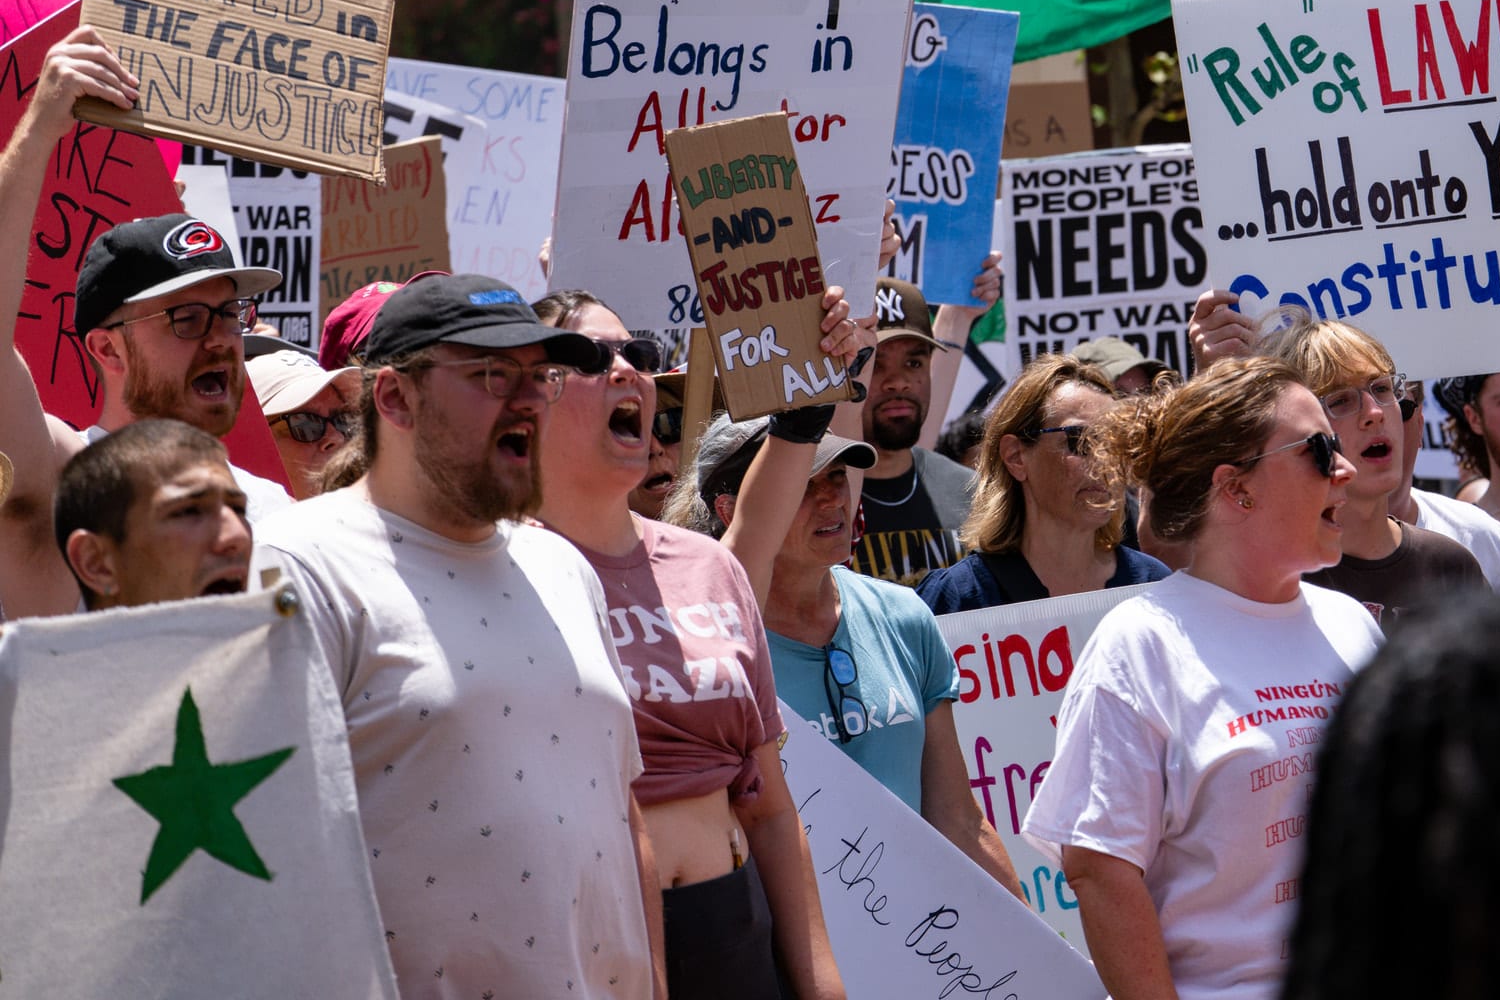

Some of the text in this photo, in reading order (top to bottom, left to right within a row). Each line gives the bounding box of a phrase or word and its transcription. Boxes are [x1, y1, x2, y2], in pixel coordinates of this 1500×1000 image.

[205, 20, 312, 81] FACE
[322, 50, 378, 92] OF
[581, 3, 853, 111] Belongs in
[117, 46, 382, 157] INJUSTICE
[458, 75, 556, 123] SOME
[1312, 51, 1369, 115] of
[680, 154, 798, 211] LIBERTY
[1012, 162, 1135, 191] MONEY
[1012, 179, 1201, 217] PEOPLE'S
[1367, 149, 1469, 220] onto
[246, 205, 312, 231] WAR
[1014, 205, 1208, 302] NEEDS
[699, 255, 826, 316] JUSTICE
[719, 325, 790, 373] FOR
[1018, 309, 1105, 337] NOT
[781, 354, 848, 404] ALL
[608, 601, 747, 647] UNCH
[1226, 704, 1329, 738] HUMANO
[821, 826, 892, 926] the
